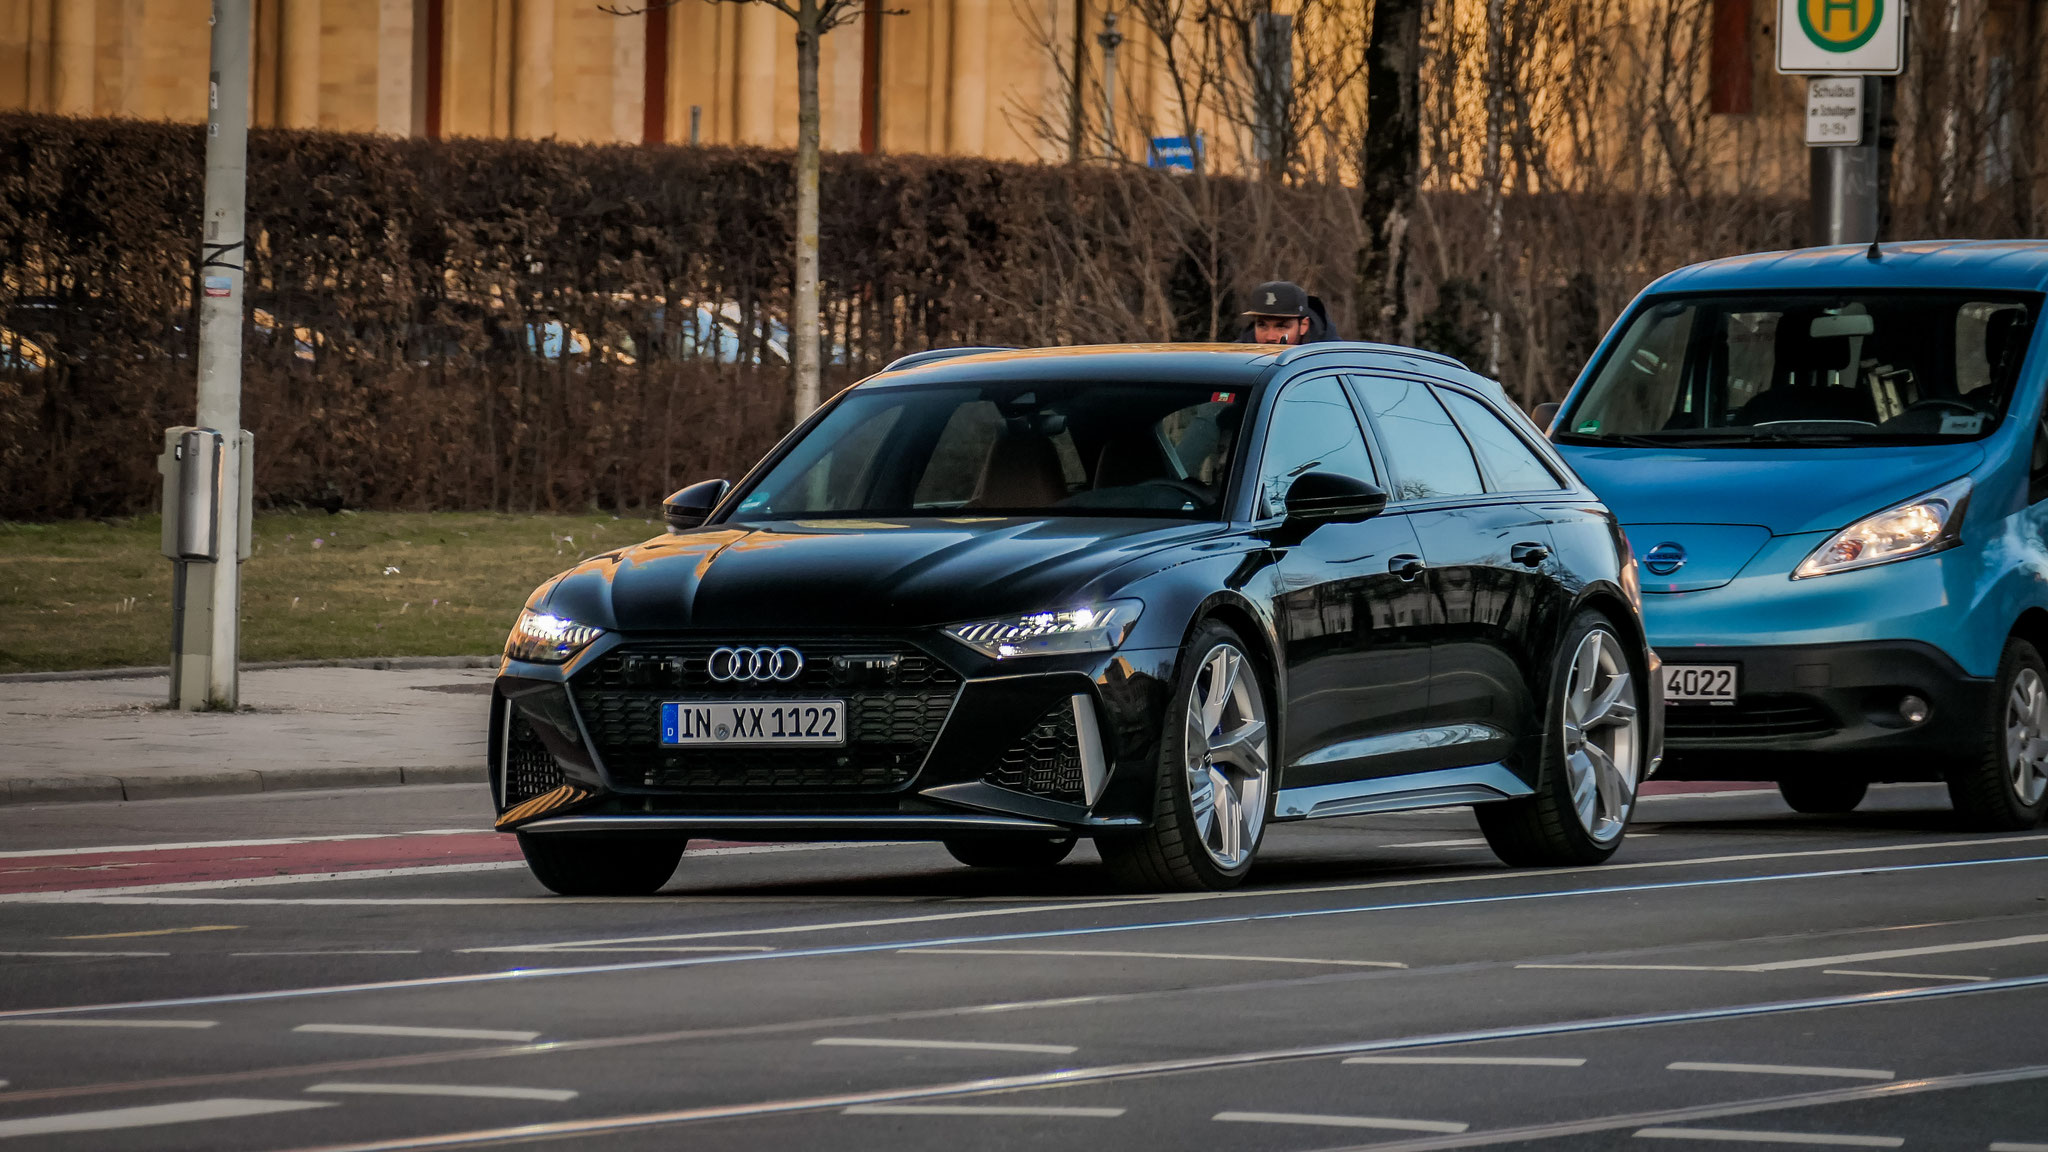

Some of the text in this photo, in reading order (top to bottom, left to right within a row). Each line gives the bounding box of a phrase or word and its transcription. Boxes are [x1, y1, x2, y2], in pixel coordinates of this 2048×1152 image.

[1823, 0, 1857, 32] H
[1812, 83, 1855, 98] Schulbus
[1667, 669, 1732, 696] 4022
[667, 707, 837, 738] D IN XX 1122
